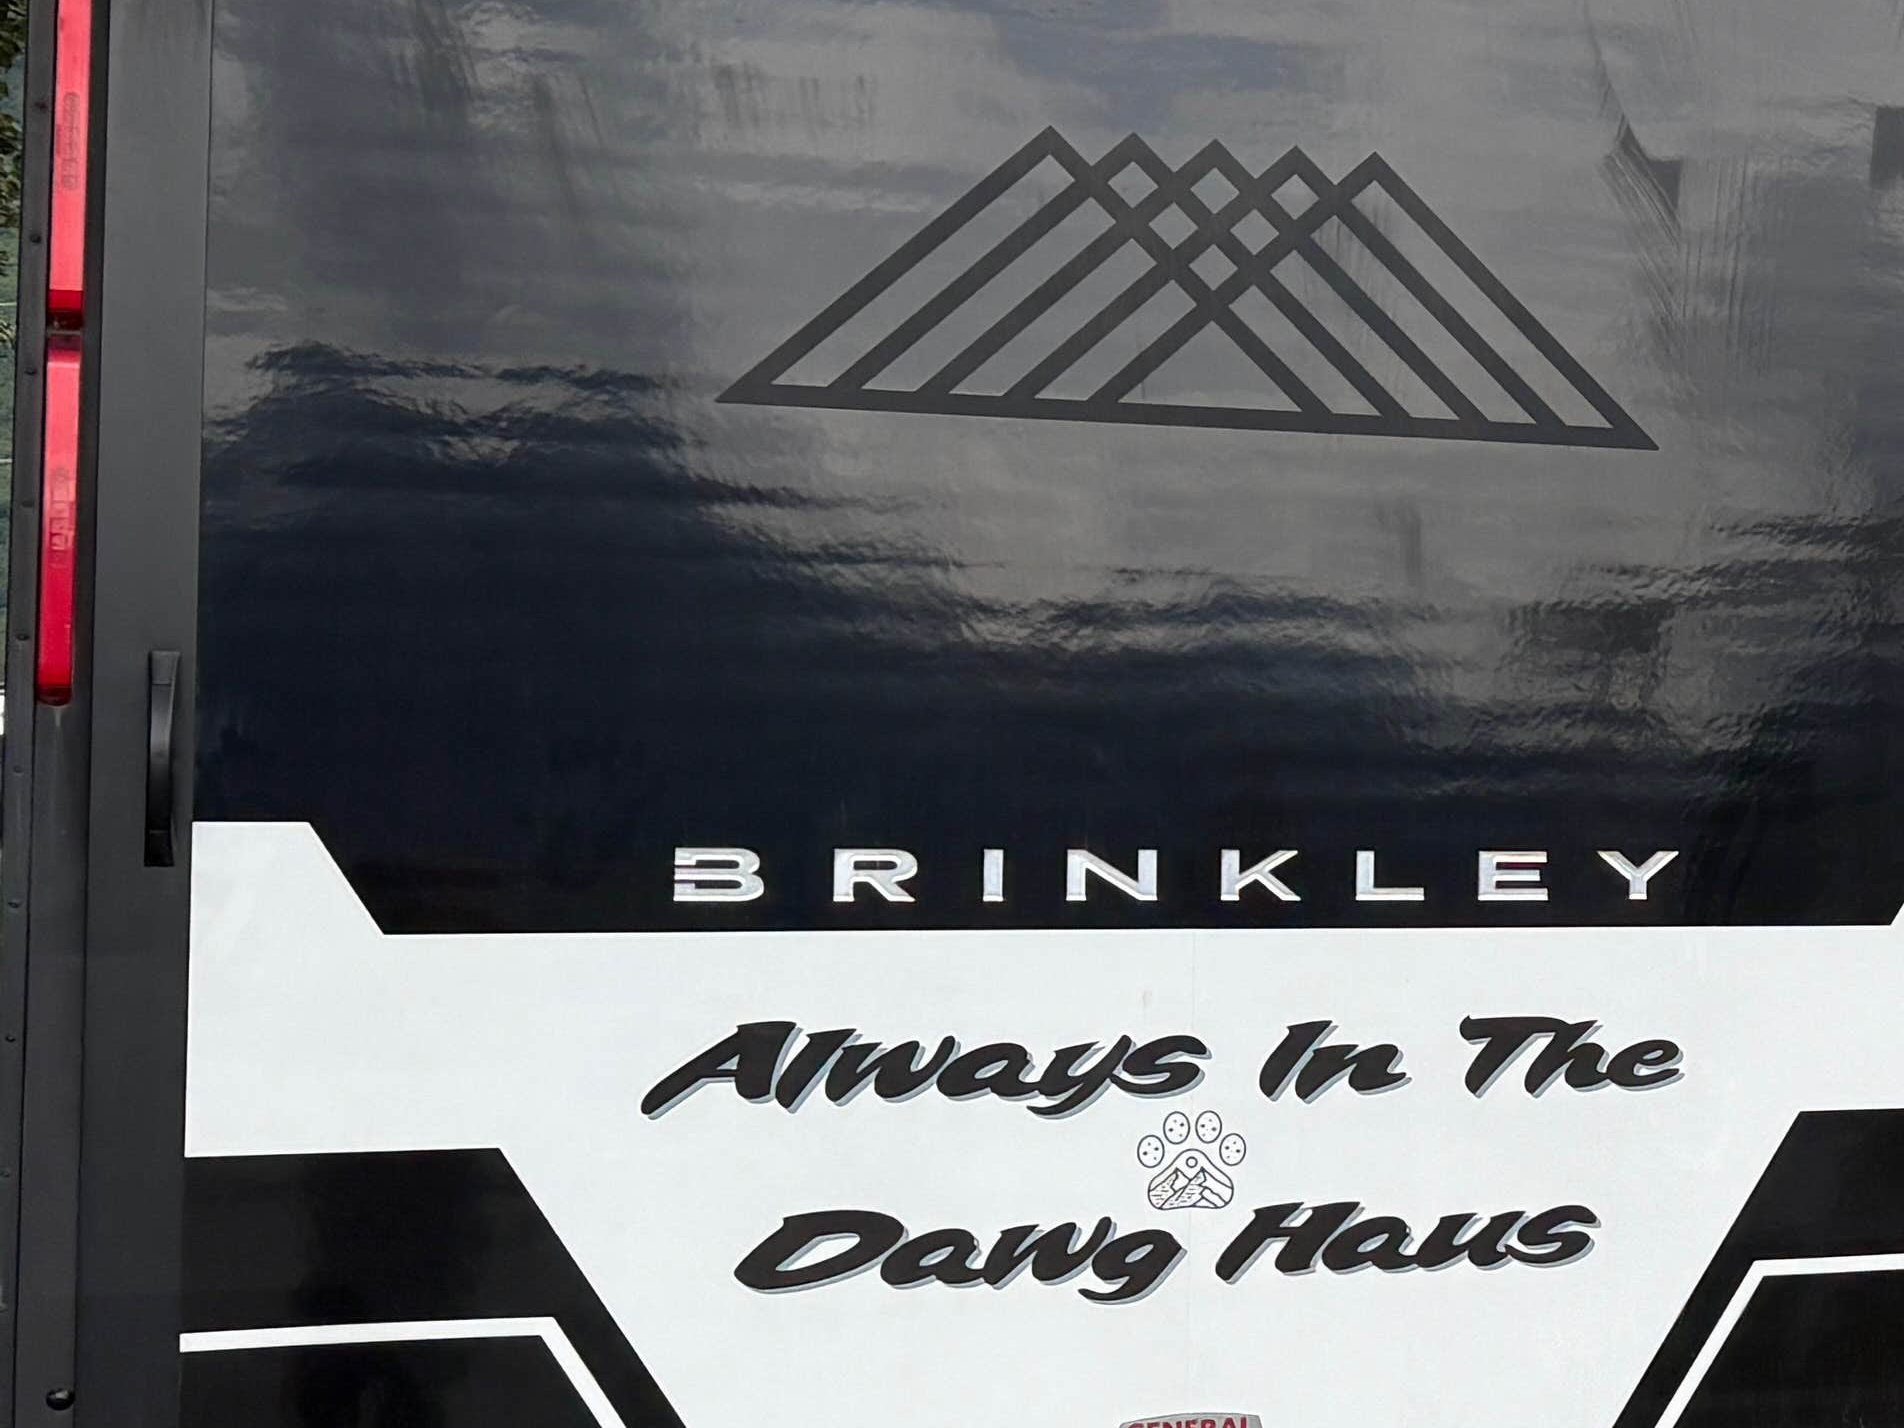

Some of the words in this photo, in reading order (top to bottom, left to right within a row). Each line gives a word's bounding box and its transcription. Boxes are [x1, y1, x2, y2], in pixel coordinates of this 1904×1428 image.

[672, 847, 1680, 903] BRINKLEY
[639, 1019, 1213, 1120] Always
[1258, 1018, 1413, 1105] In
[1457, 1013, 1686, 1099] The
[733, 1209, 1188, 1306] Dawg
[1214, 1200, 1602, 1286] Haus
